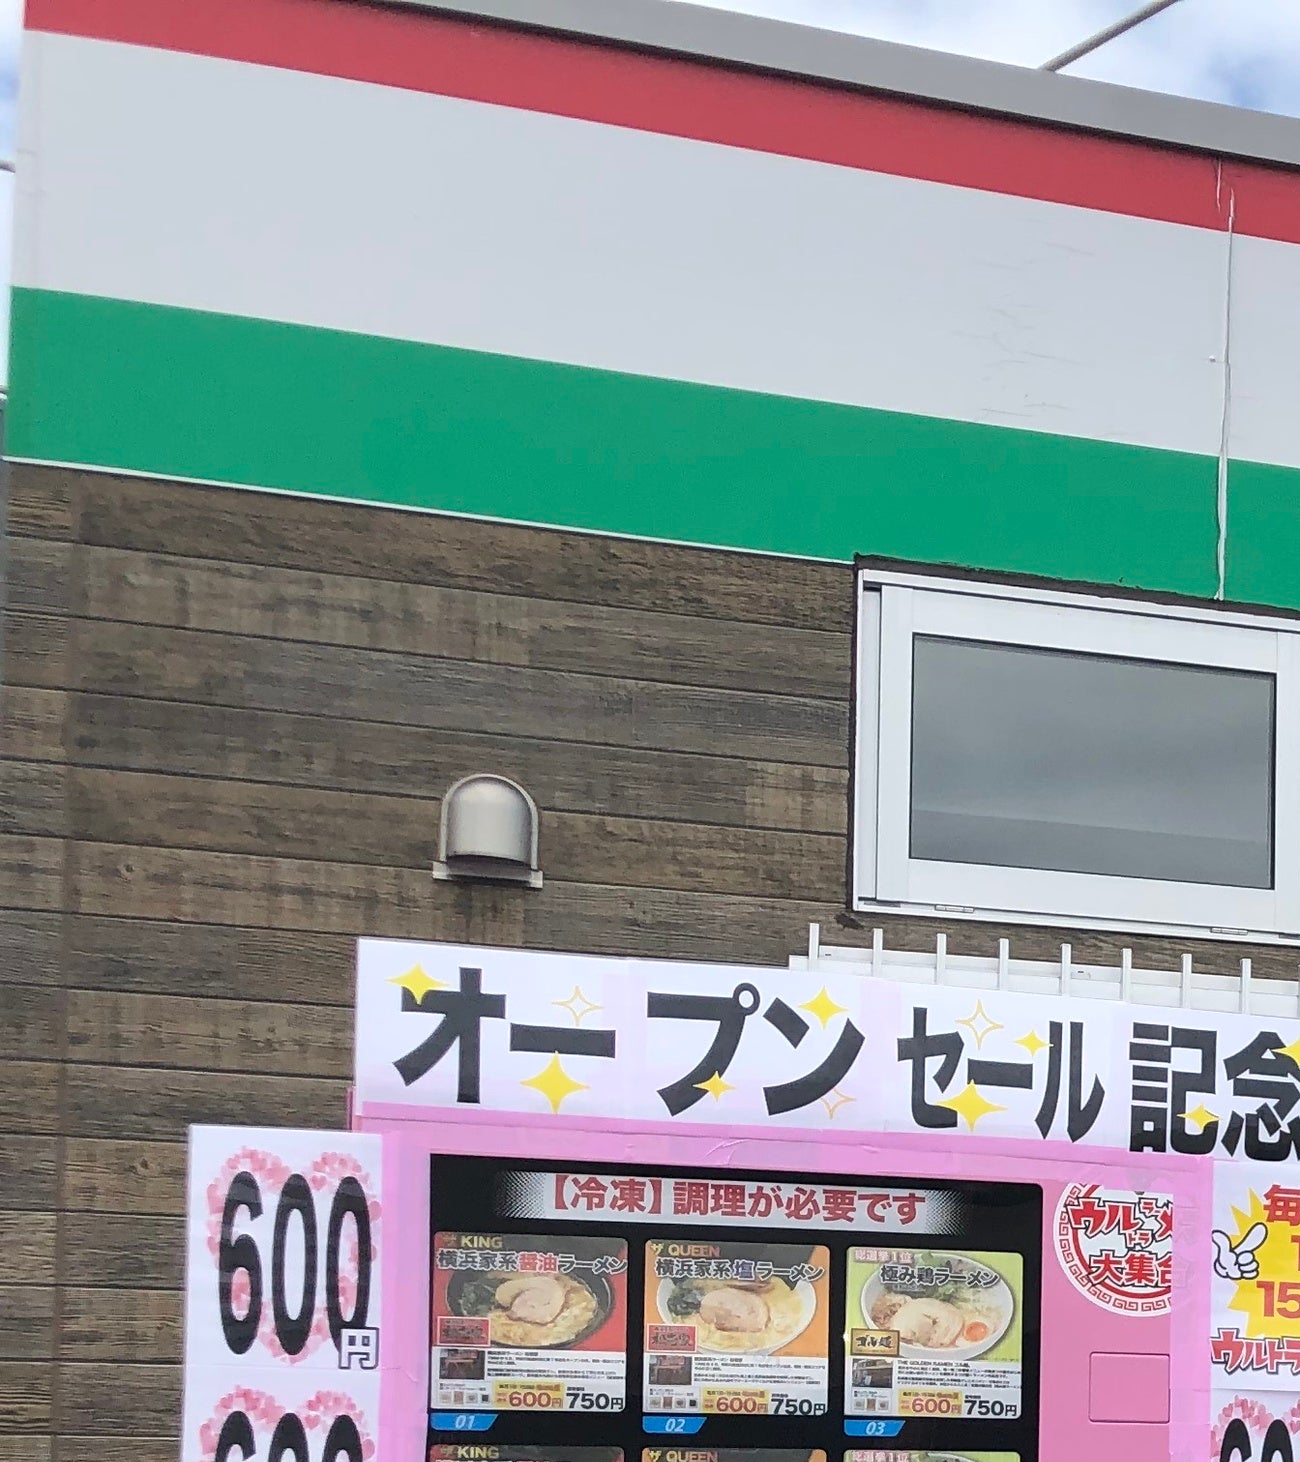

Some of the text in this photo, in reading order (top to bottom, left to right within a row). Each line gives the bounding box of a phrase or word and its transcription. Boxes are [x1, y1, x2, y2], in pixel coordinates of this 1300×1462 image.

[461, 1235, 503, 1248] KING
[668, 1244, 720, 1257] QUEEN
[437, 1248, 628, 1274] 横浜家系醤油ラーメン
[218, 1171, 378, 1370] 600円
[880, 1265, 1001, 1287] 極み鶏ラーメン
[566, 1392, 624, 1410] 750円
[771, 1398, 826, 1416] 750円
[964, 1400, 1017, 1417] 750円
[455, 1415, 475, 1430] 01
[665, 1418, 685, 1432] 02
[865, 1422, 886, 1436] 03
[457, 1446, 499, 1459] KING
[666, 1450, 718, 1462] QUEEN
